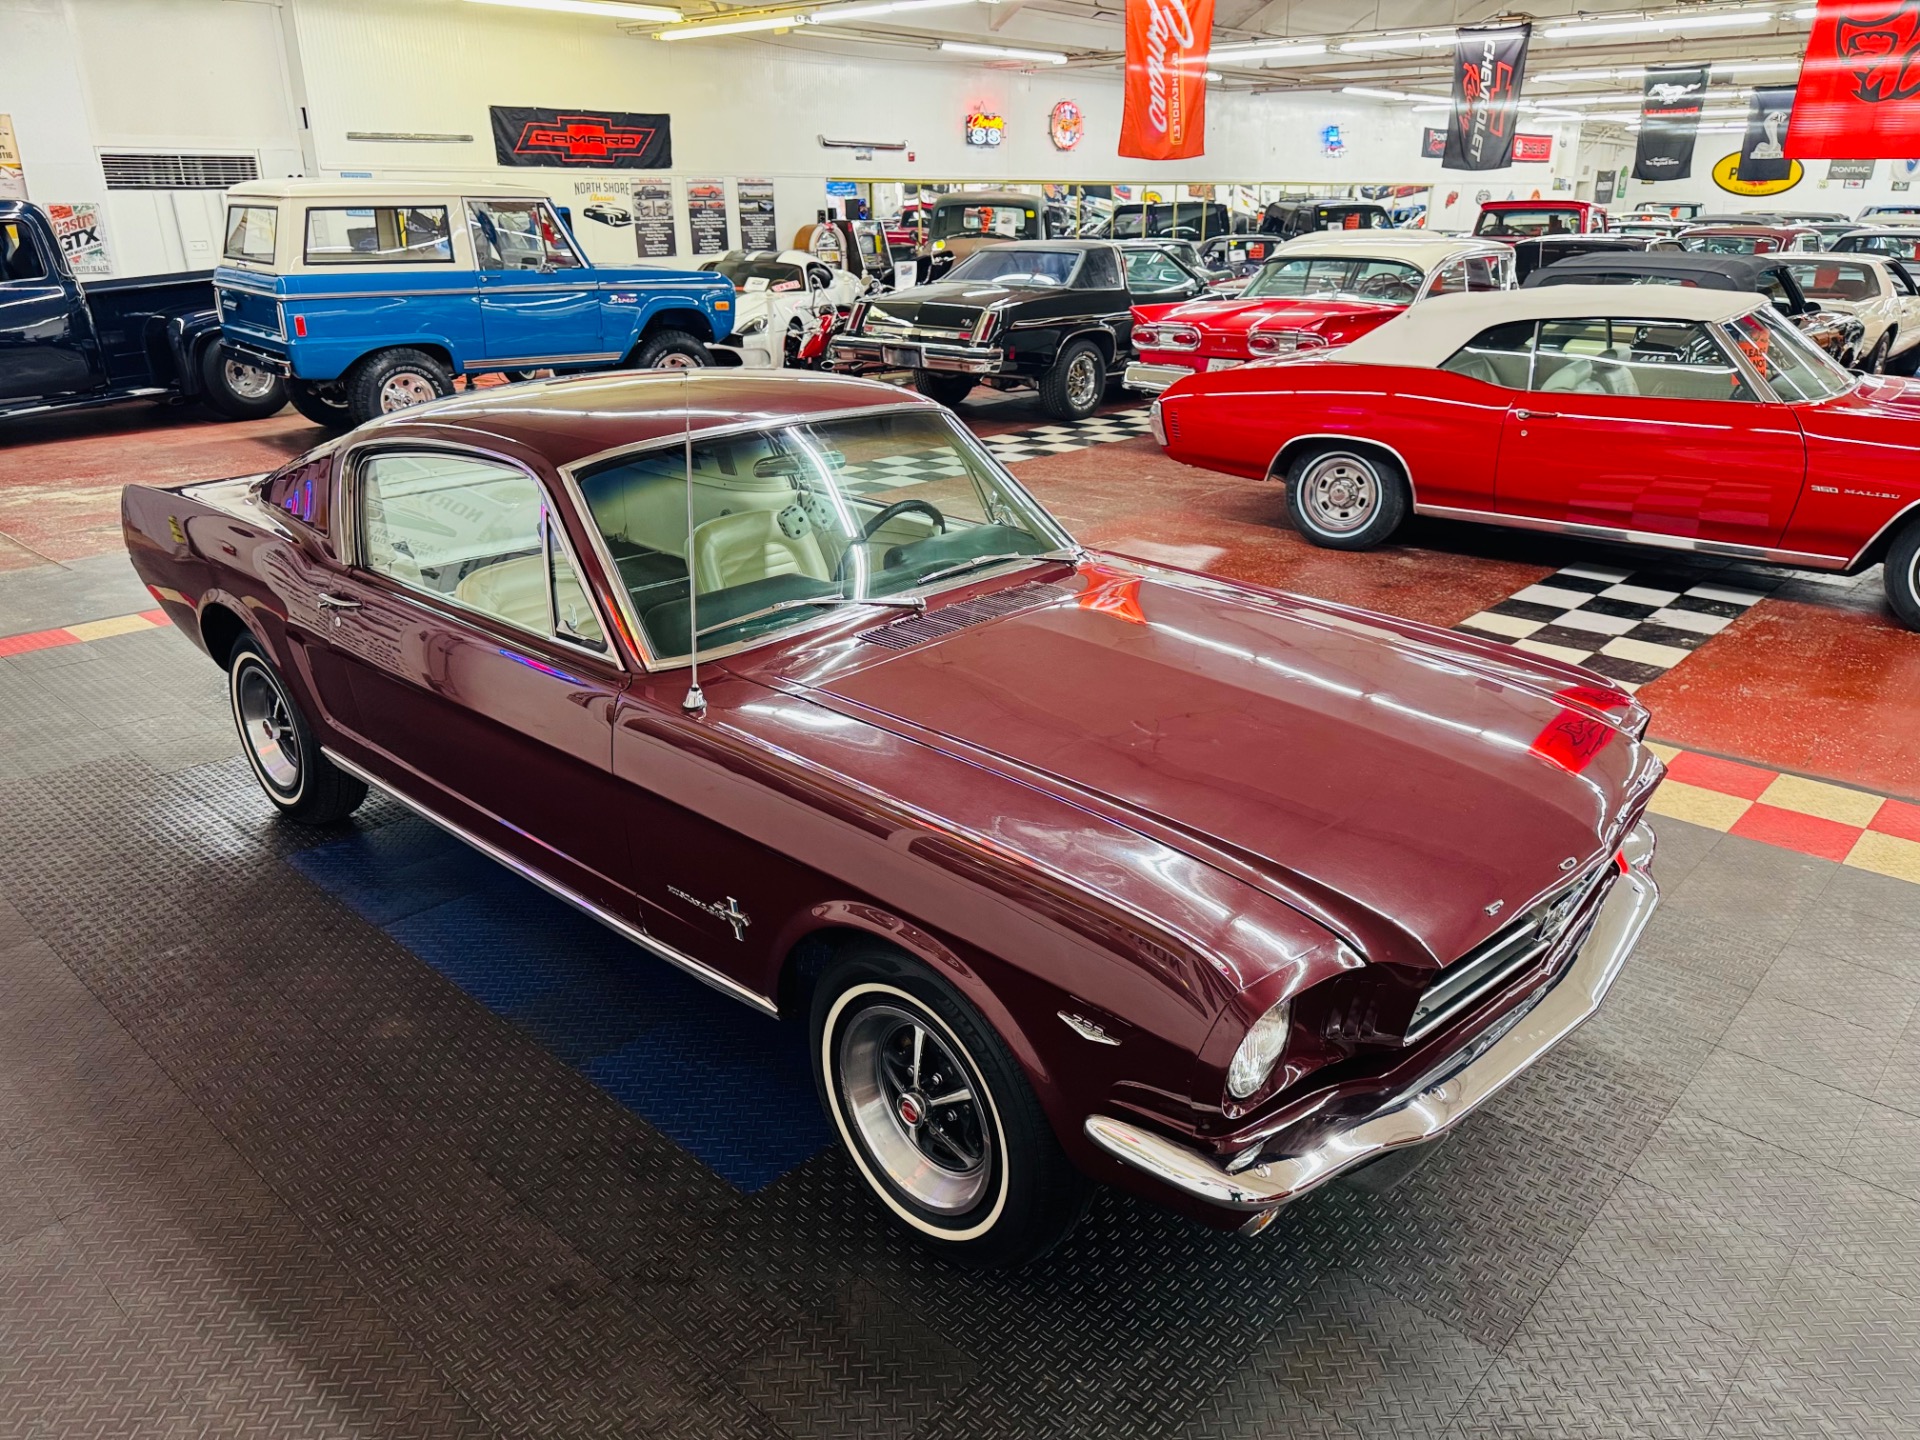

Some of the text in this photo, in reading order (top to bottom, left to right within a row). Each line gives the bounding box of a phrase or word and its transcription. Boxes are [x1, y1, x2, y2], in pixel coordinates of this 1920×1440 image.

[1171, 67, 1181, 139] CHEVROLET
[1470, 40, 1496, 163] CHEVROLET
[535, 132, 636, 146] CAMARO
[971, 128, 1001, 144] SS
[574, 182, 630, 196] NORTH SHORE
[59, 225, 101, 252] GTX
[1843, 488, 1901, 499] MALIBU
